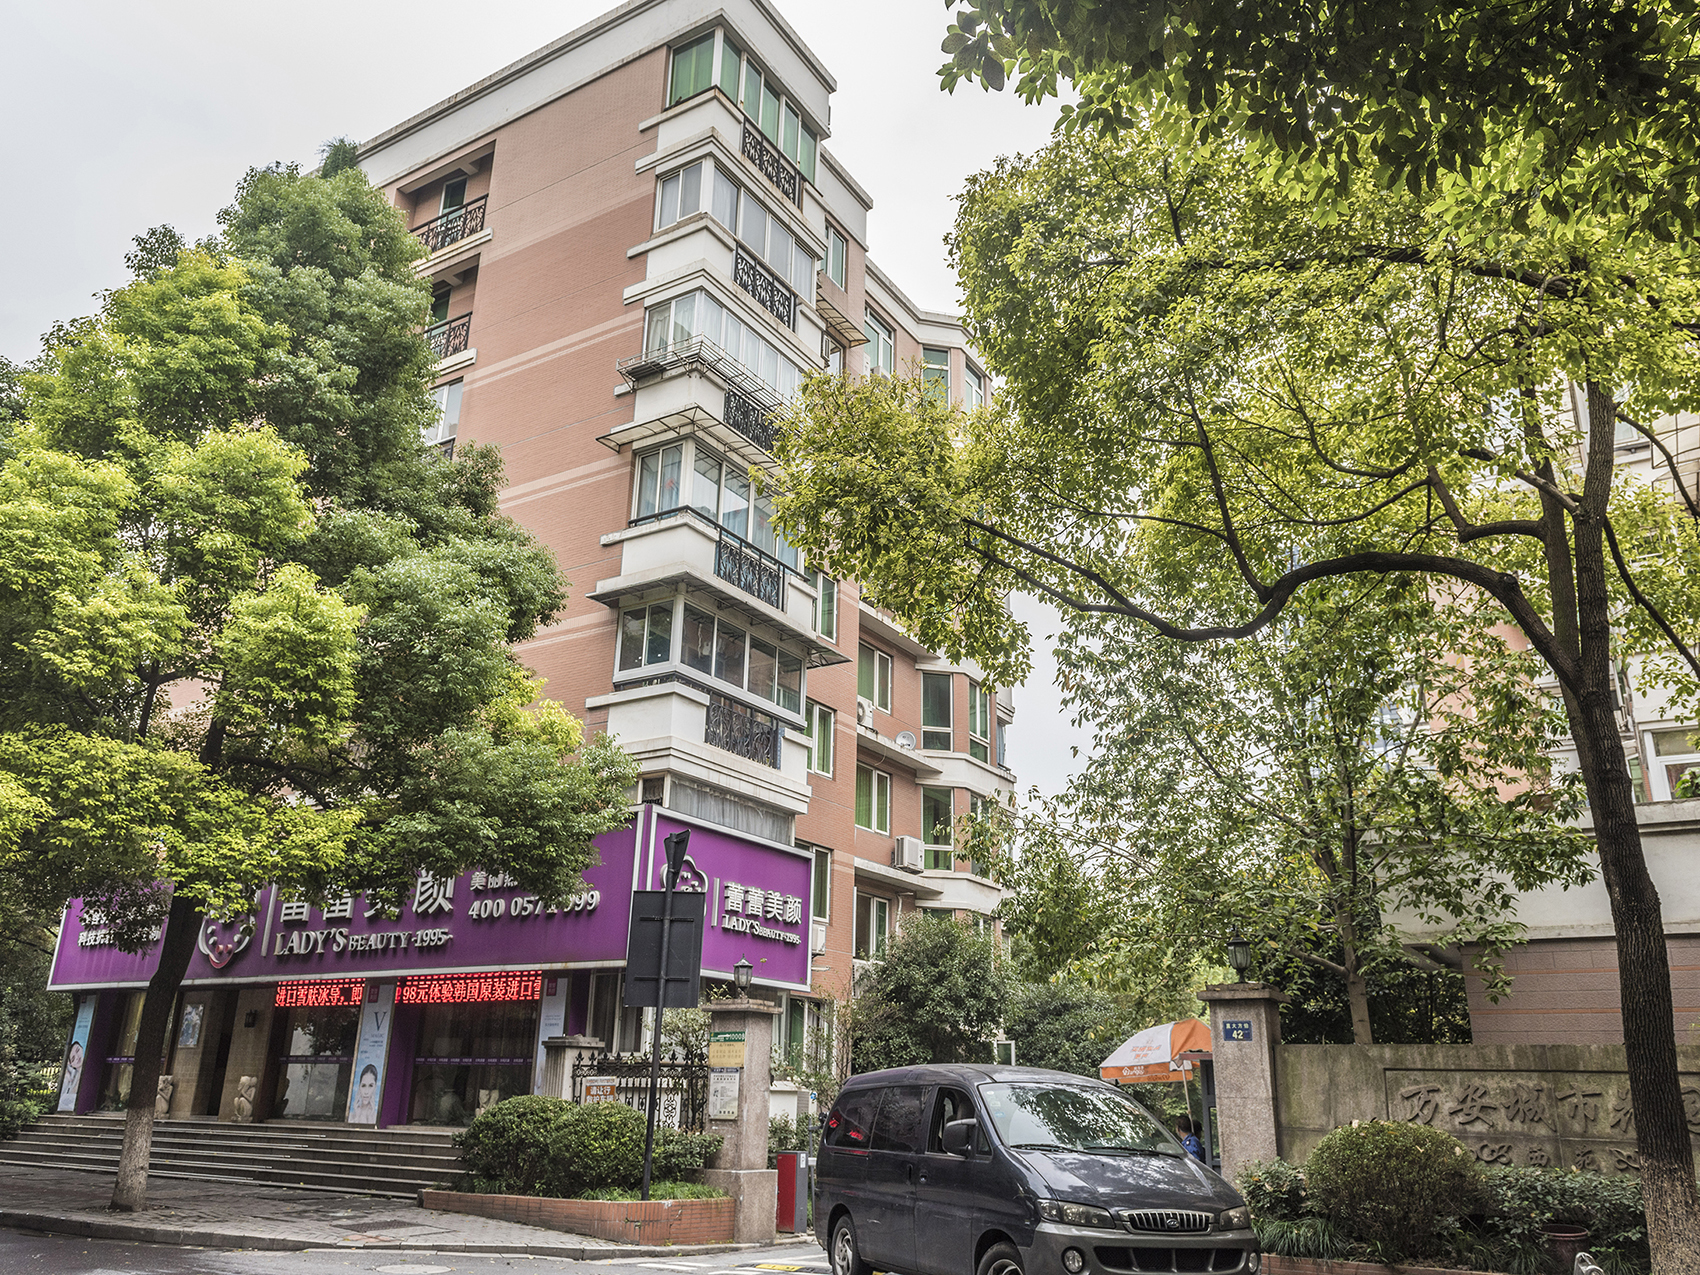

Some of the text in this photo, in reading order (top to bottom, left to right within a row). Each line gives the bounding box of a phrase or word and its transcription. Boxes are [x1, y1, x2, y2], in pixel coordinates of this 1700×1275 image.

[468, 898, 506, 919] 400
[510, 896, 557, 917] 057
[724, 881, 802, 925] 蕾蕾美颜
[348, 931, 412, 951] BEAUTY
[374, 1011, 387, 1031] V
[1232, 1030, 1244, 1040] 42
